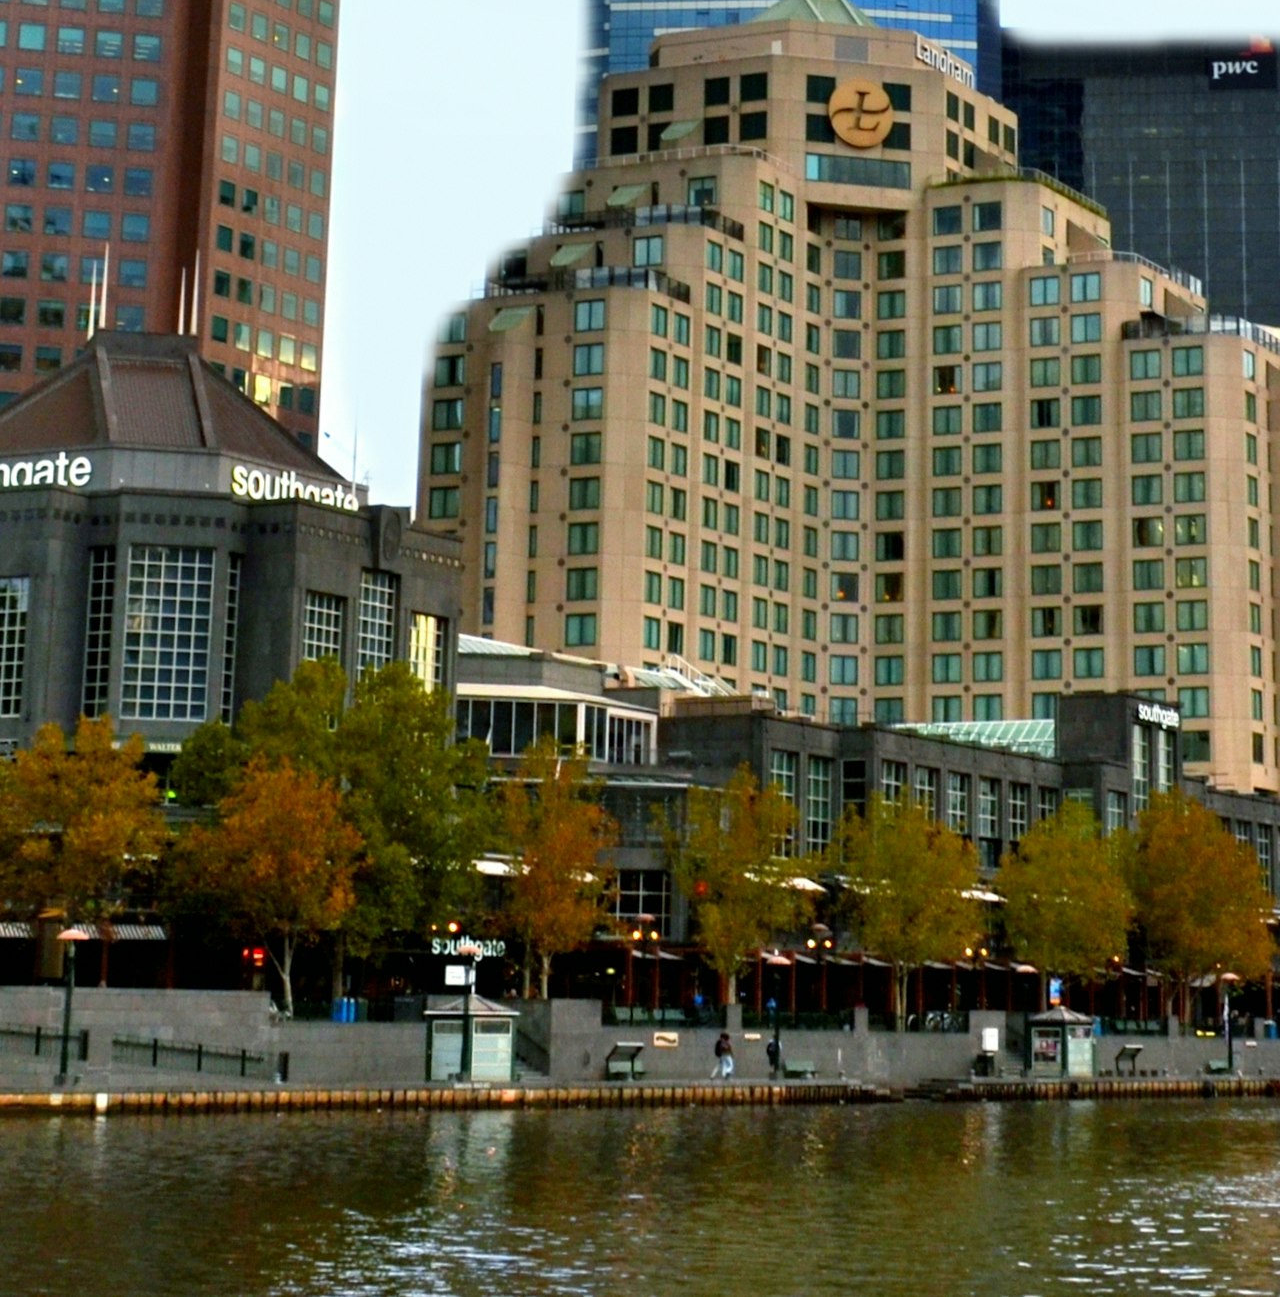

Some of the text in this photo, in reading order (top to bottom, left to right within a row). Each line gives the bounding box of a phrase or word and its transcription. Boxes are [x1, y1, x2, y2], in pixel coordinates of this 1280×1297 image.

[1211, 60, 1259, 80] pwc
[1138, 703, 1180, 730] southgate
[431, 934, 506, 962] southgate
